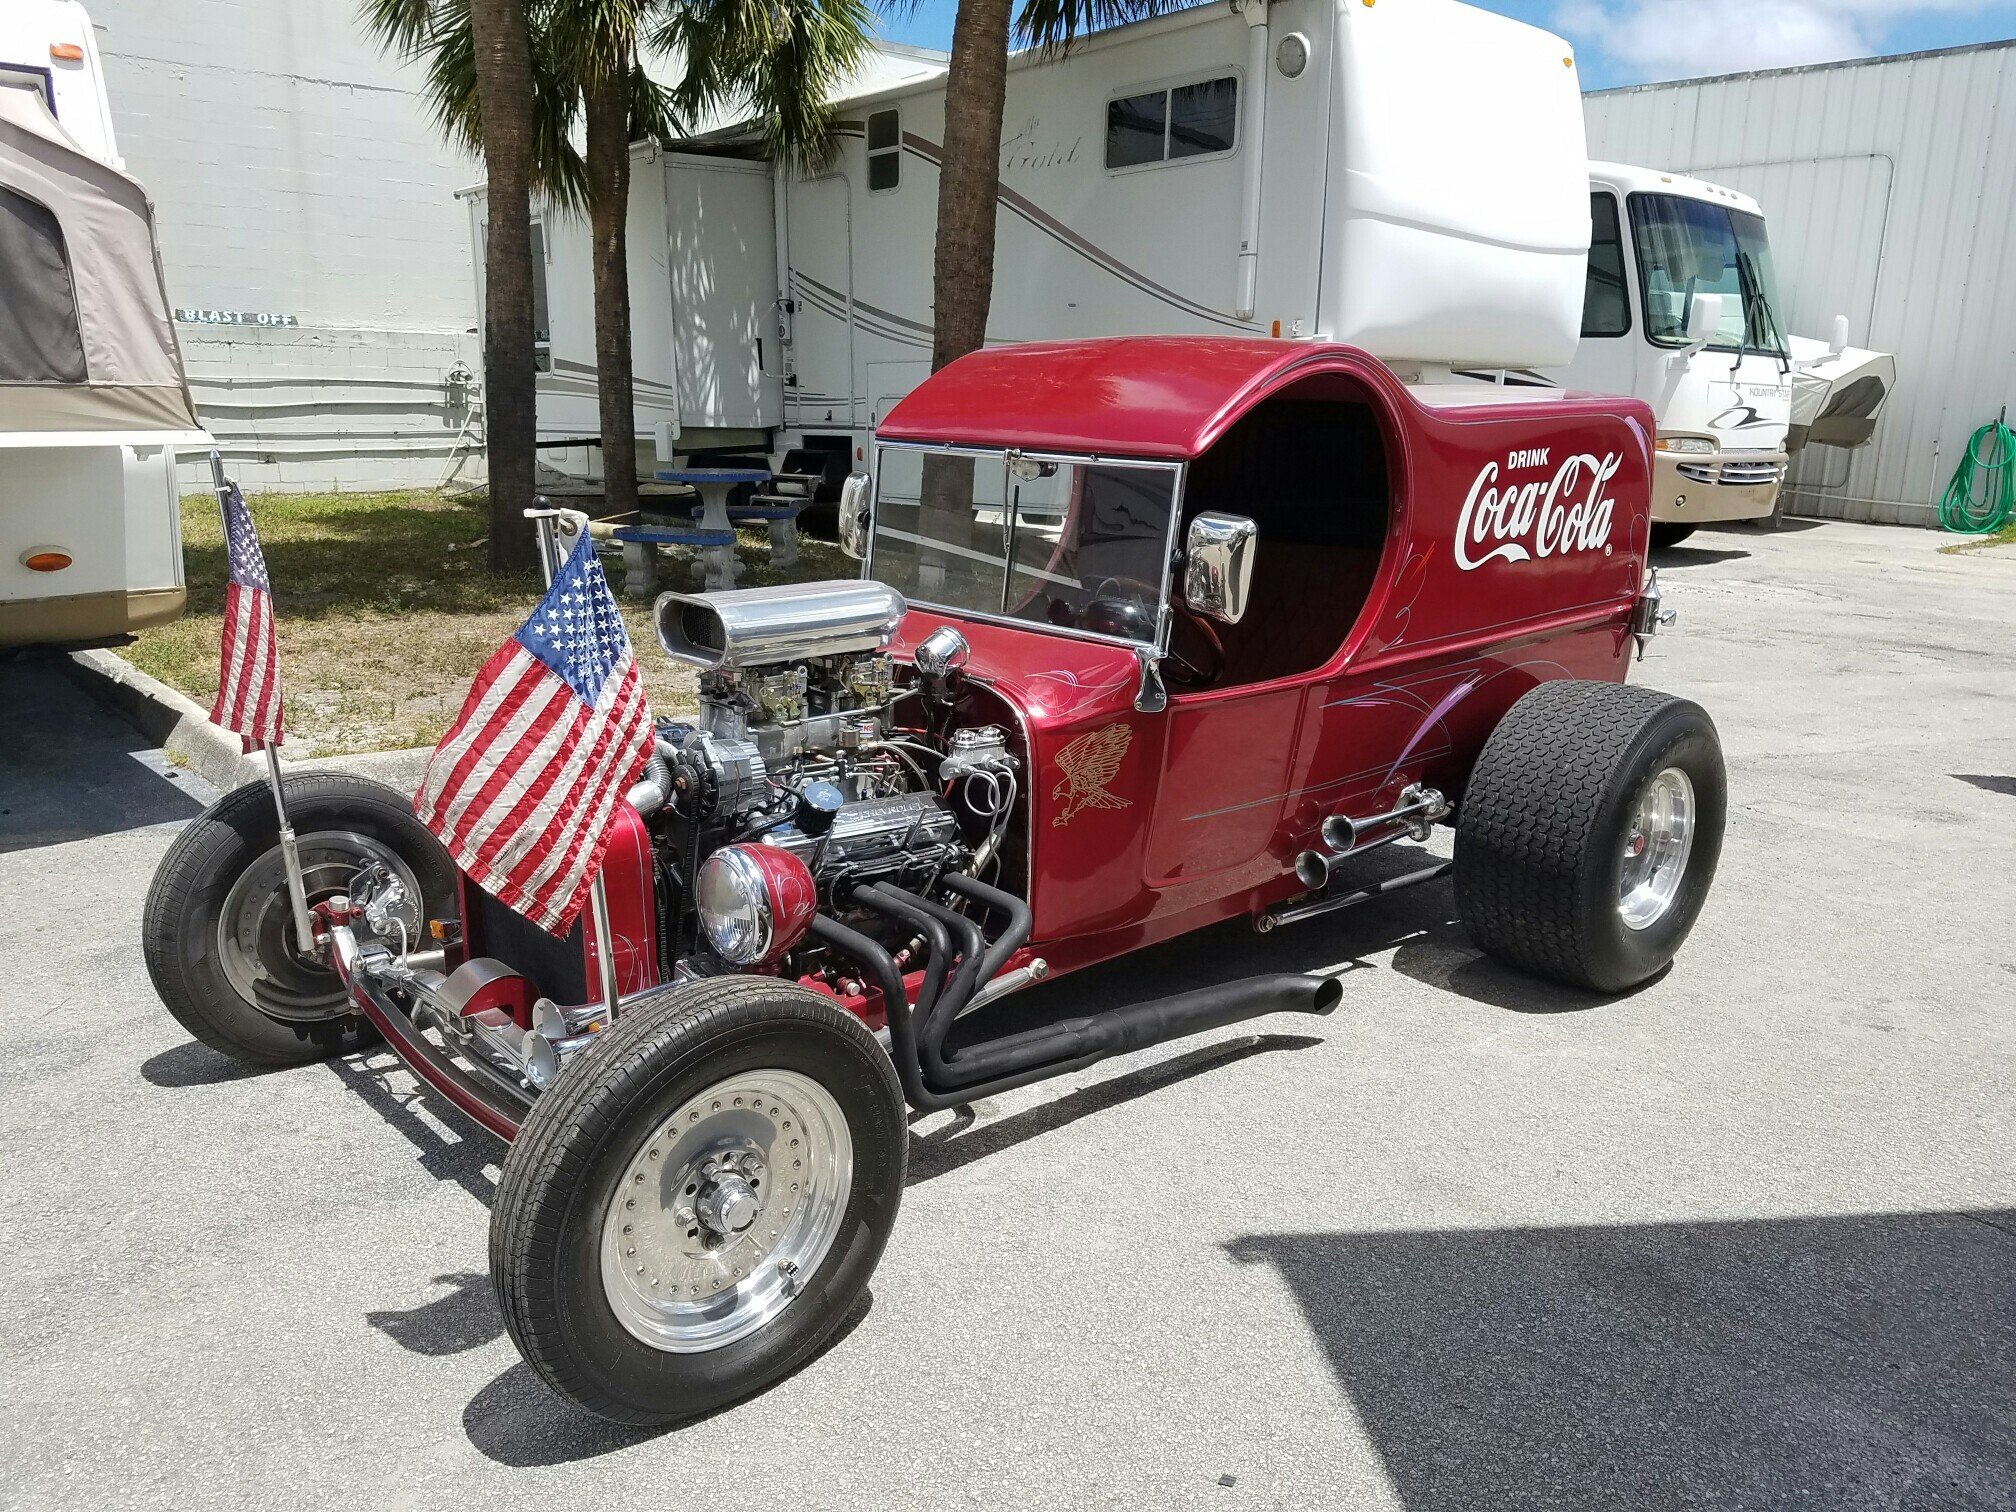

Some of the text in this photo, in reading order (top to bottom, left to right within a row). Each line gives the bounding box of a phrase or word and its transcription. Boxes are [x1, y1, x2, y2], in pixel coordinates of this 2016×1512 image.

[184, 309, 292, 326] BLAST OFF
[1508, 448, 1550, 470] DRINK
[1455, 452, 1623, 571] Coca-Cola
